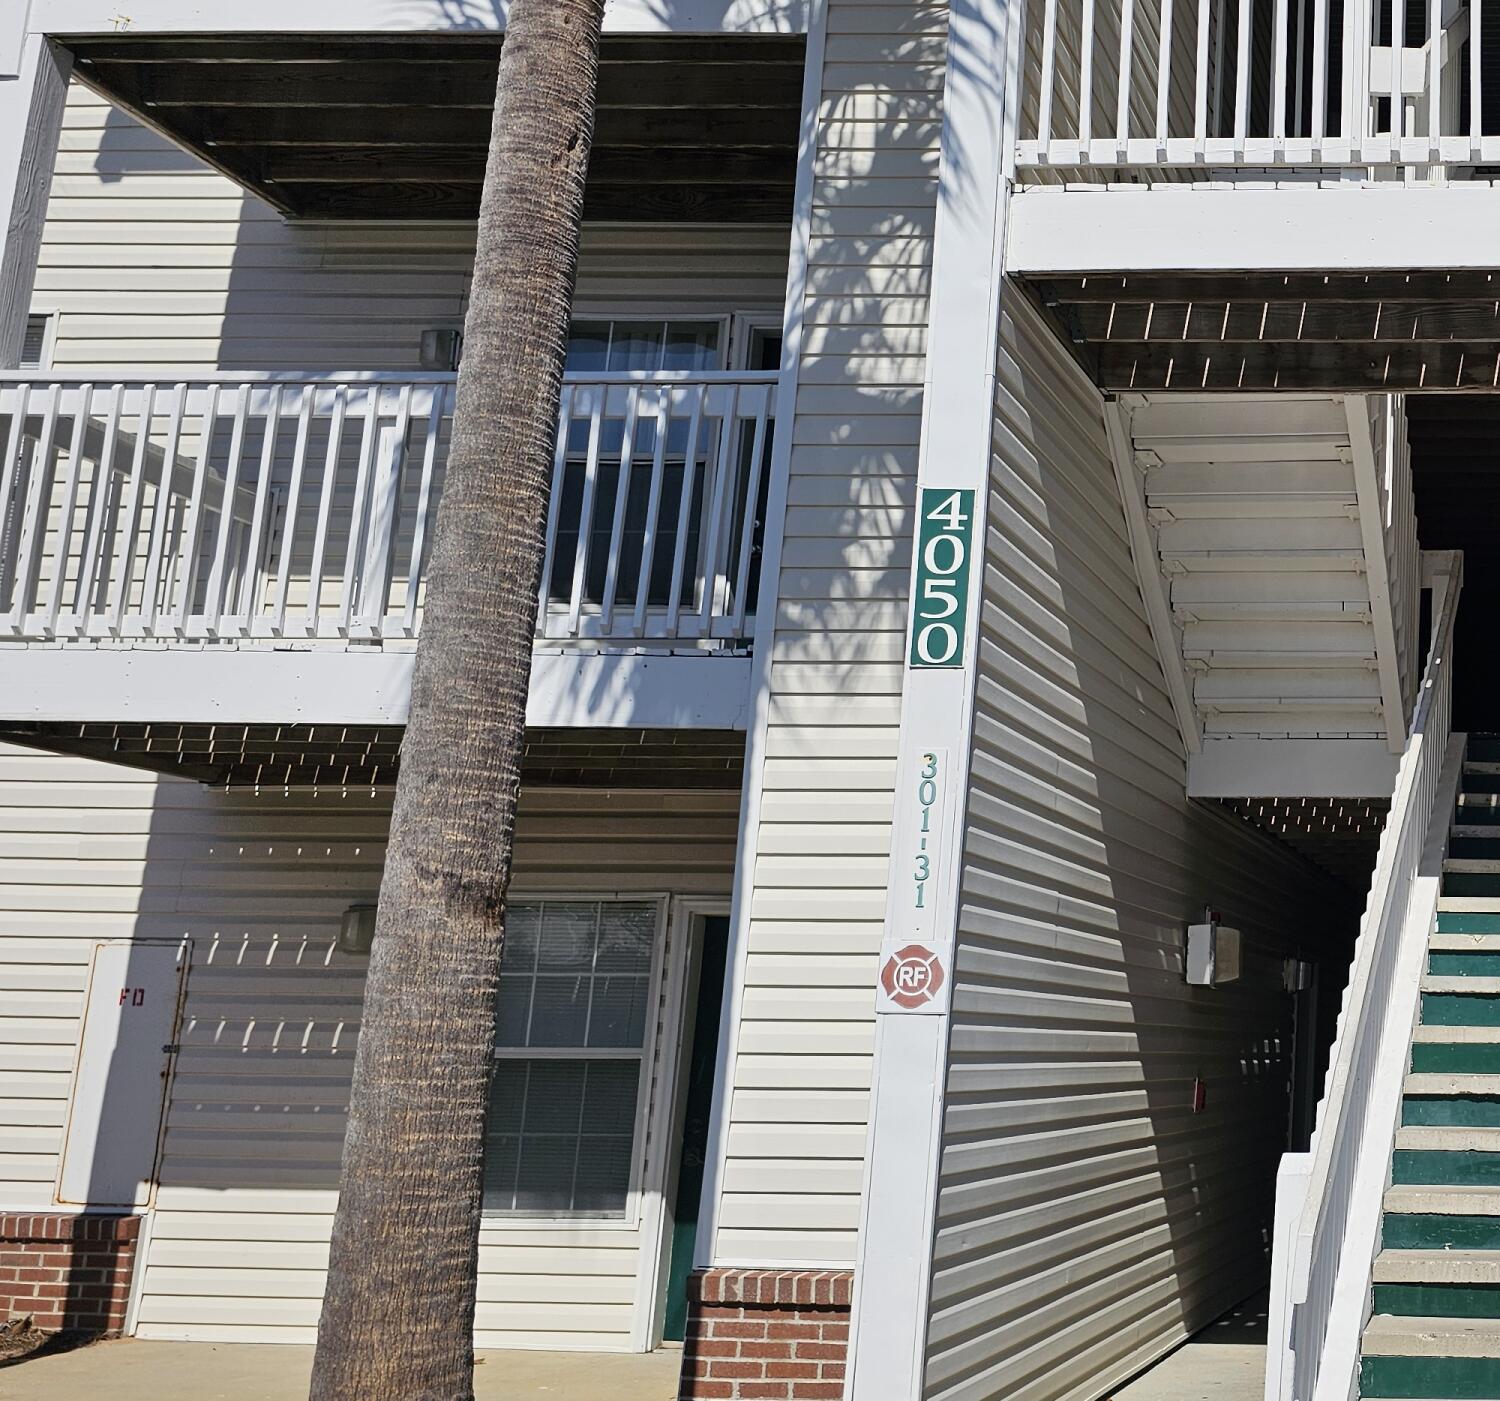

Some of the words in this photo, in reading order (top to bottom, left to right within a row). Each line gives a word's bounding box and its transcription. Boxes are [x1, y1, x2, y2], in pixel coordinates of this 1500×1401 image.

[917, 491, 968, 664] 4050
[914, 752, 938, 908] 301-31
[899, 967, 926, 987] RF
